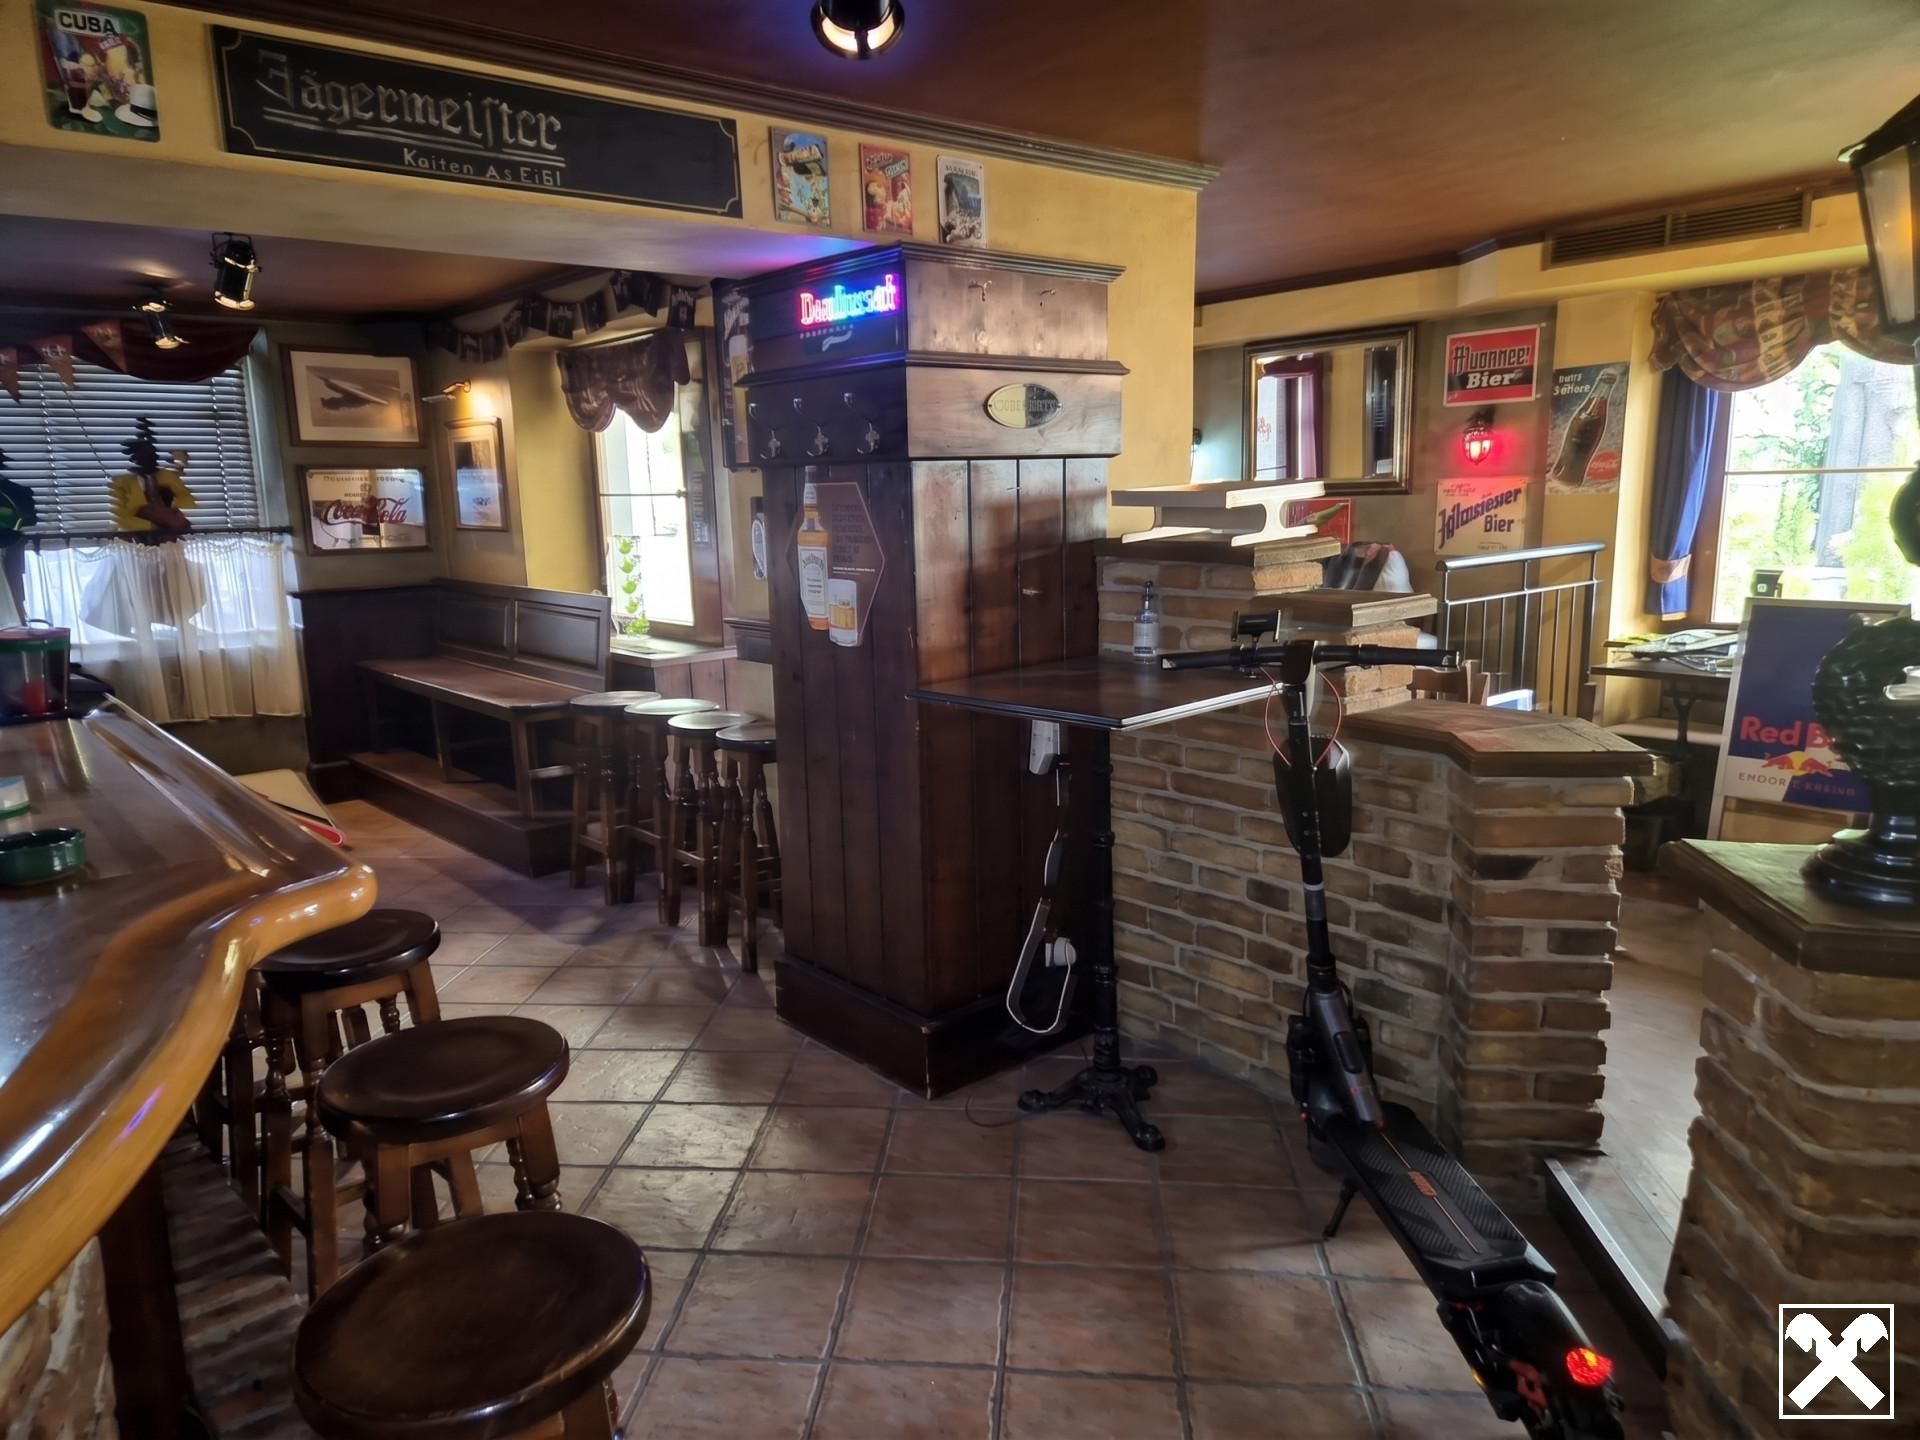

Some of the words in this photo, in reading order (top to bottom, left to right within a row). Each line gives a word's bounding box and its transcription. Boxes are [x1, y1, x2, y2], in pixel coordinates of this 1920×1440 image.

[58, 12, 120, 36] CUBA
[1466, 371, 1516, 389] Bier
[325, 497, 409, 526] CocaCola
[1483, 514, 1515, 533] Bier
[1740, 716, 1803, 746] Red
